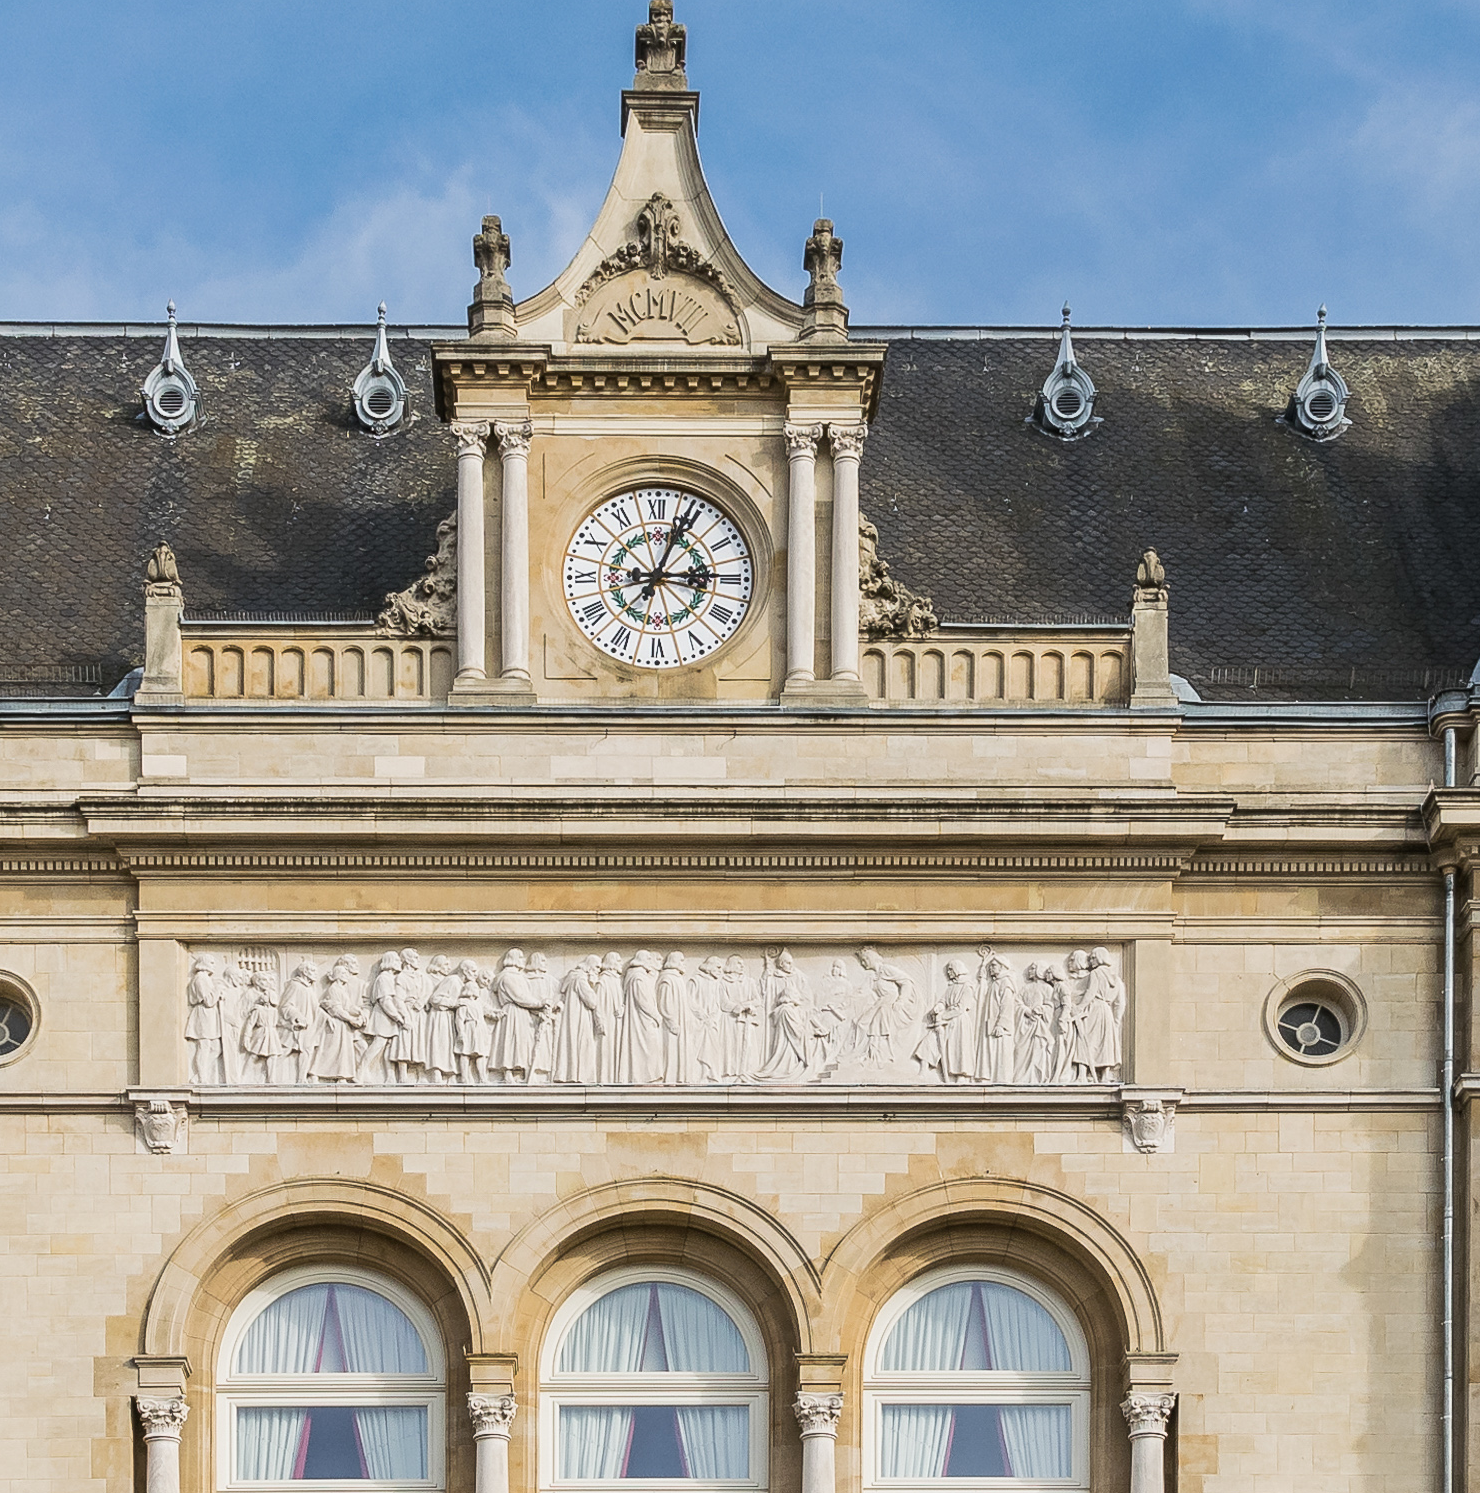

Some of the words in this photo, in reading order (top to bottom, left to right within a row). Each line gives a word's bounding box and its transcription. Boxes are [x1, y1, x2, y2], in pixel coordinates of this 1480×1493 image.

[611, 507, 632, 530] XI
[648, 499, 666, 520] XII
[584, 533, 608, 553] X
[710, 537, 732, 552] II
[575, 570, 596, 583] IX
[582, 600, 607, 626] VIII
[611, 626, 631, 650] VII
[651, 638, 665, 658] VI
[687, 630, 704, 651] V
